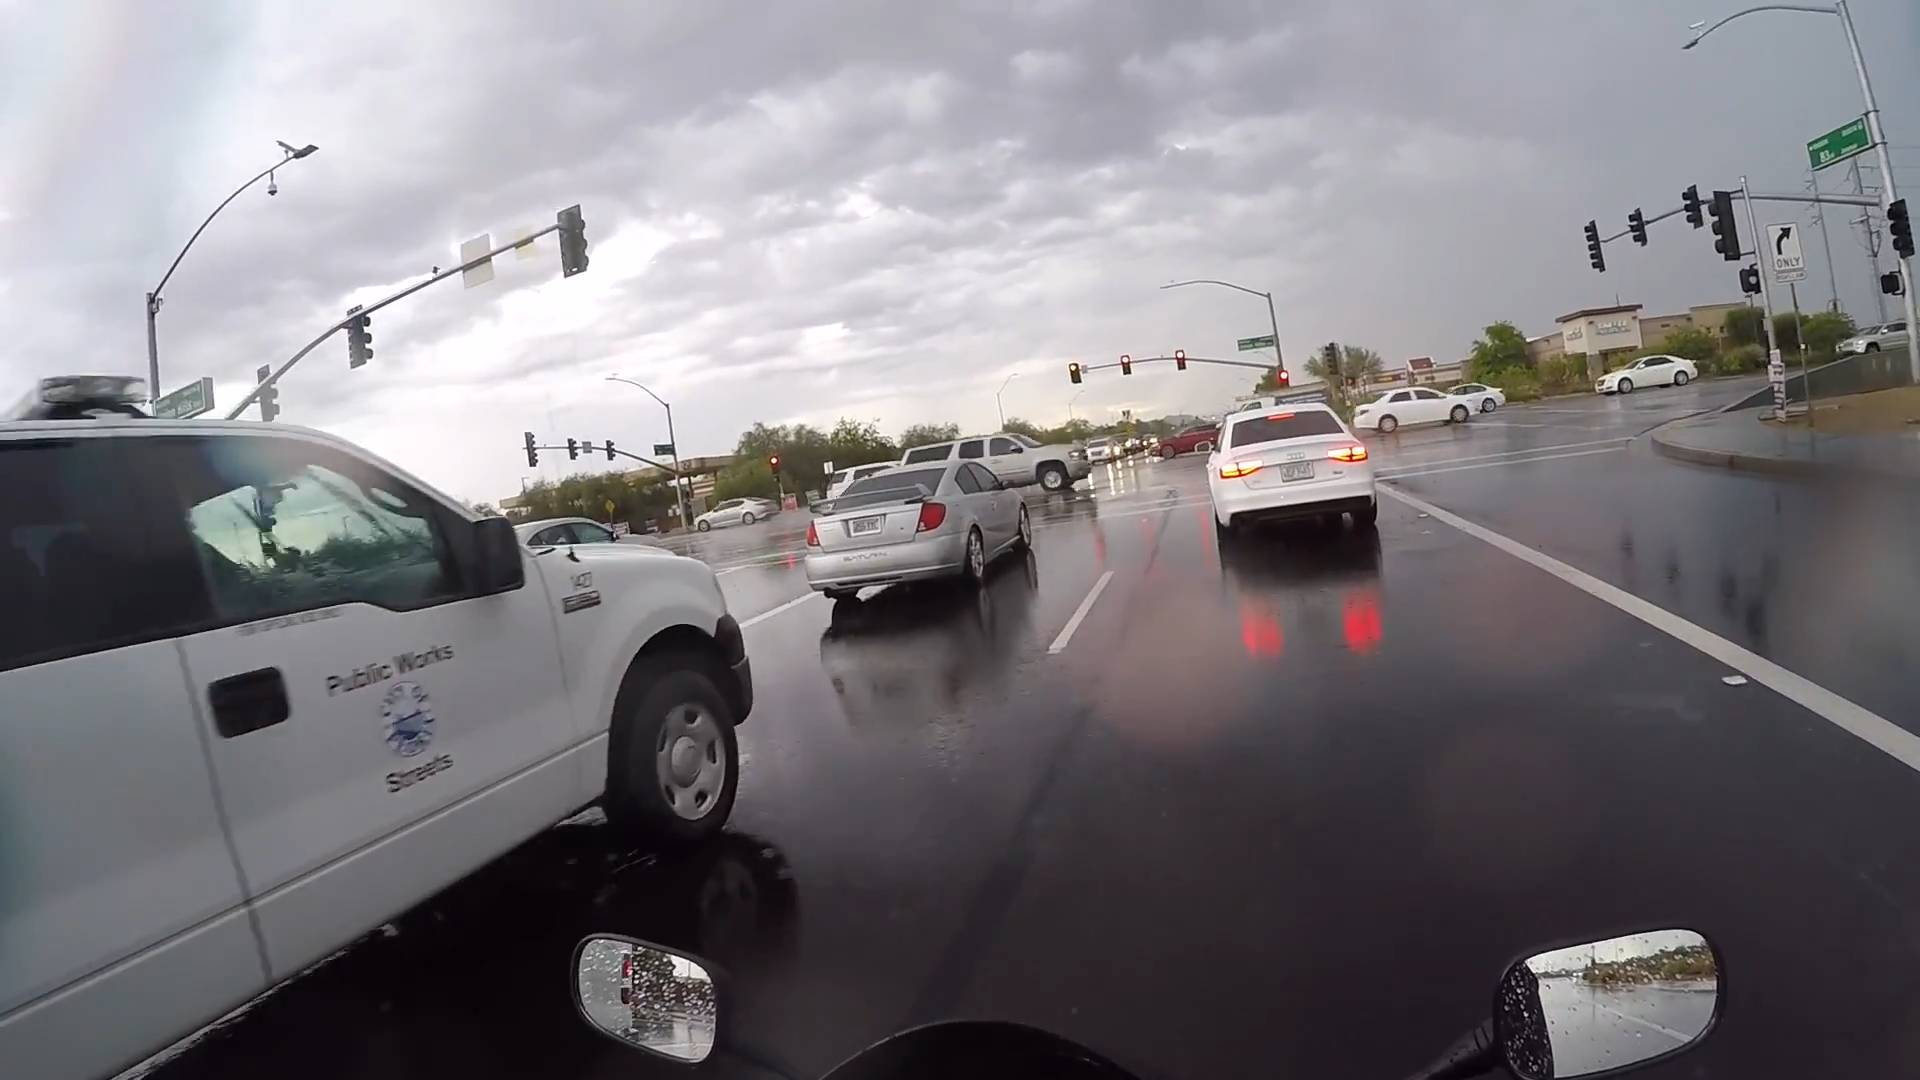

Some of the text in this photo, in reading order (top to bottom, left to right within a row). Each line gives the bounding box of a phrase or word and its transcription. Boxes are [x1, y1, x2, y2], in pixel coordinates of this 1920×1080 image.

[1776, 256, 1801, 269] ONLY
[326, 645, 454, 697] Public Works
[386, 754, 454, 793] Streets
